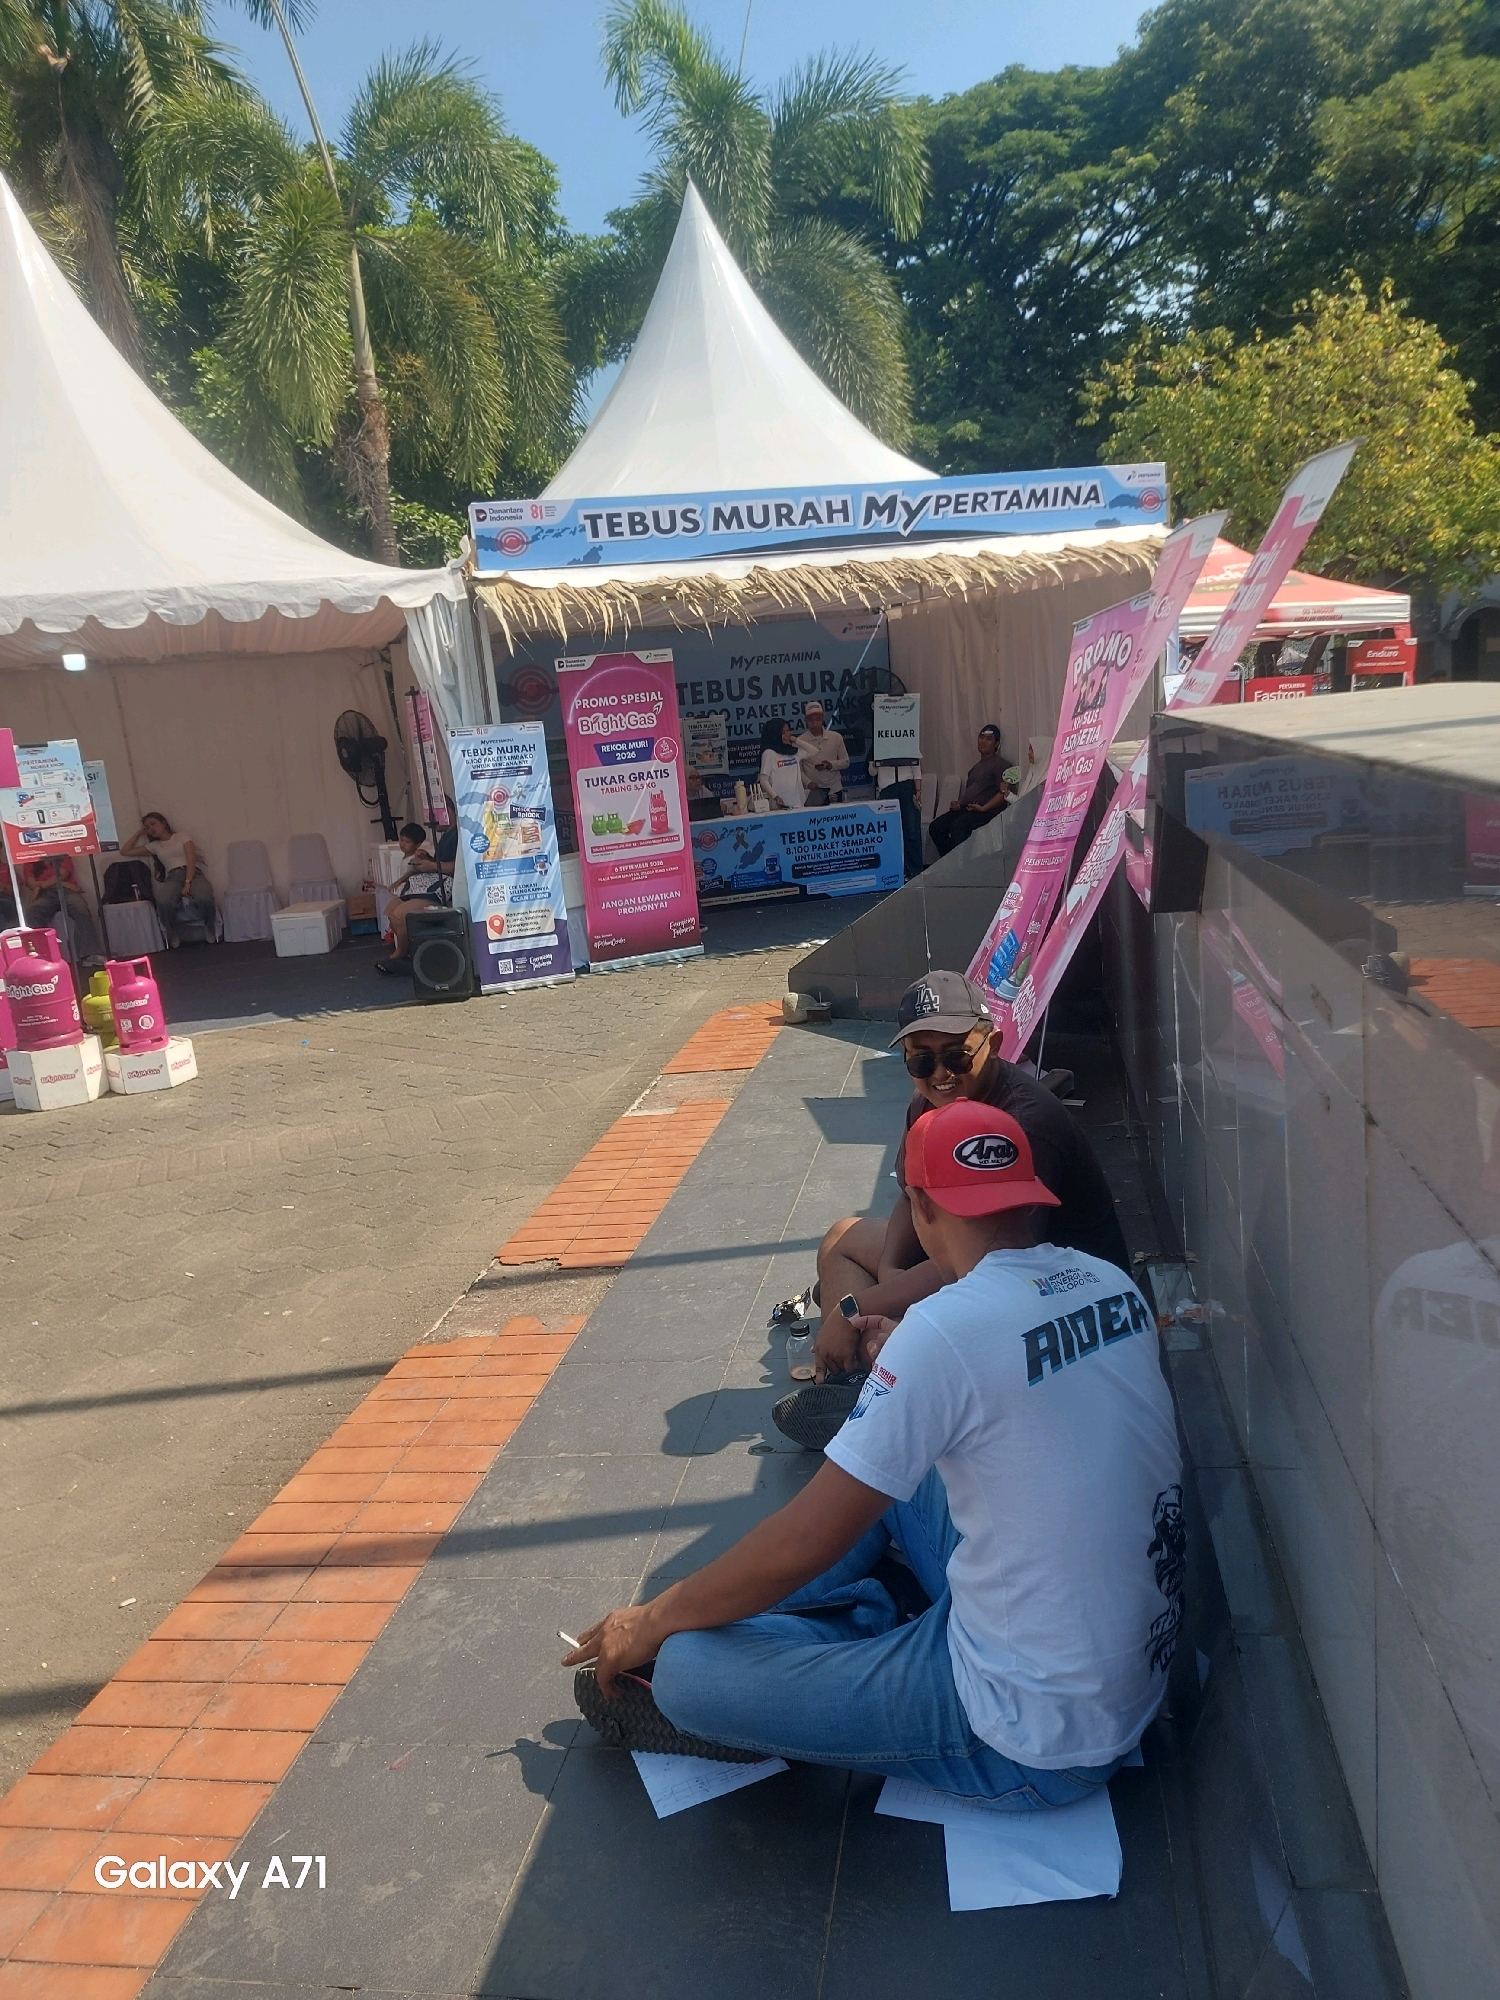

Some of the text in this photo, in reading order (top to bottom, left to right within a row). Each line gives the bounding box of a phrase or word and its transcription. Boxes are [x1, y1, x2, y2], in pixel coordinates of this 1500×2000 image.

[489, 514, 523, 522] Indonesia
[583, 483, 1101, 539] TEBUS MURAH MyPERTAMINA
[730, 650, 821, 671] MyPERTAMINA
[1073, 632, 1133, 687] PROMO
[1367, 650, 1399, 658] Enduro
[676, 666, 878, 706] TEBUS MURAH
[575, 691, 664, 709] PROMO SPESIAL
[1254, 690, 1305, 702] Fastron
[627, 711, 657, 730] Gas
[735, 703, 787, 720] PAKET
[877, 729, 915, 738] KELUAR
[461, 744, 536, 758] TEBUS MURAH
[601, 740, 648, 752] REKOR MURI
[615, 751, 637, 760] 2026
[1075, 757, 1093, 775] Gas
[584, 769, 670, 788] TUKAR GRATIS
[601, 784, 632, 795] TABUNG
[780, 820, 888, 845] TEBUS MURAH
[786, 836, 883, 855] 8.100 PAKET SEMBAKO
[795, 853, 821, 862] UNTUK
[823, 848, 860, 859] BENCANA
[601, 890, 681, 910] JANGAN LEWATKAN
[618, 901, 668, 915] PROMONYA!
[32, 984, 54, 995] Gas
[915, 984, 940, 1016] LA
[961, 1138, 1015, 1161] Arai
[1021, 1291, 1150, 1387] RIDER
